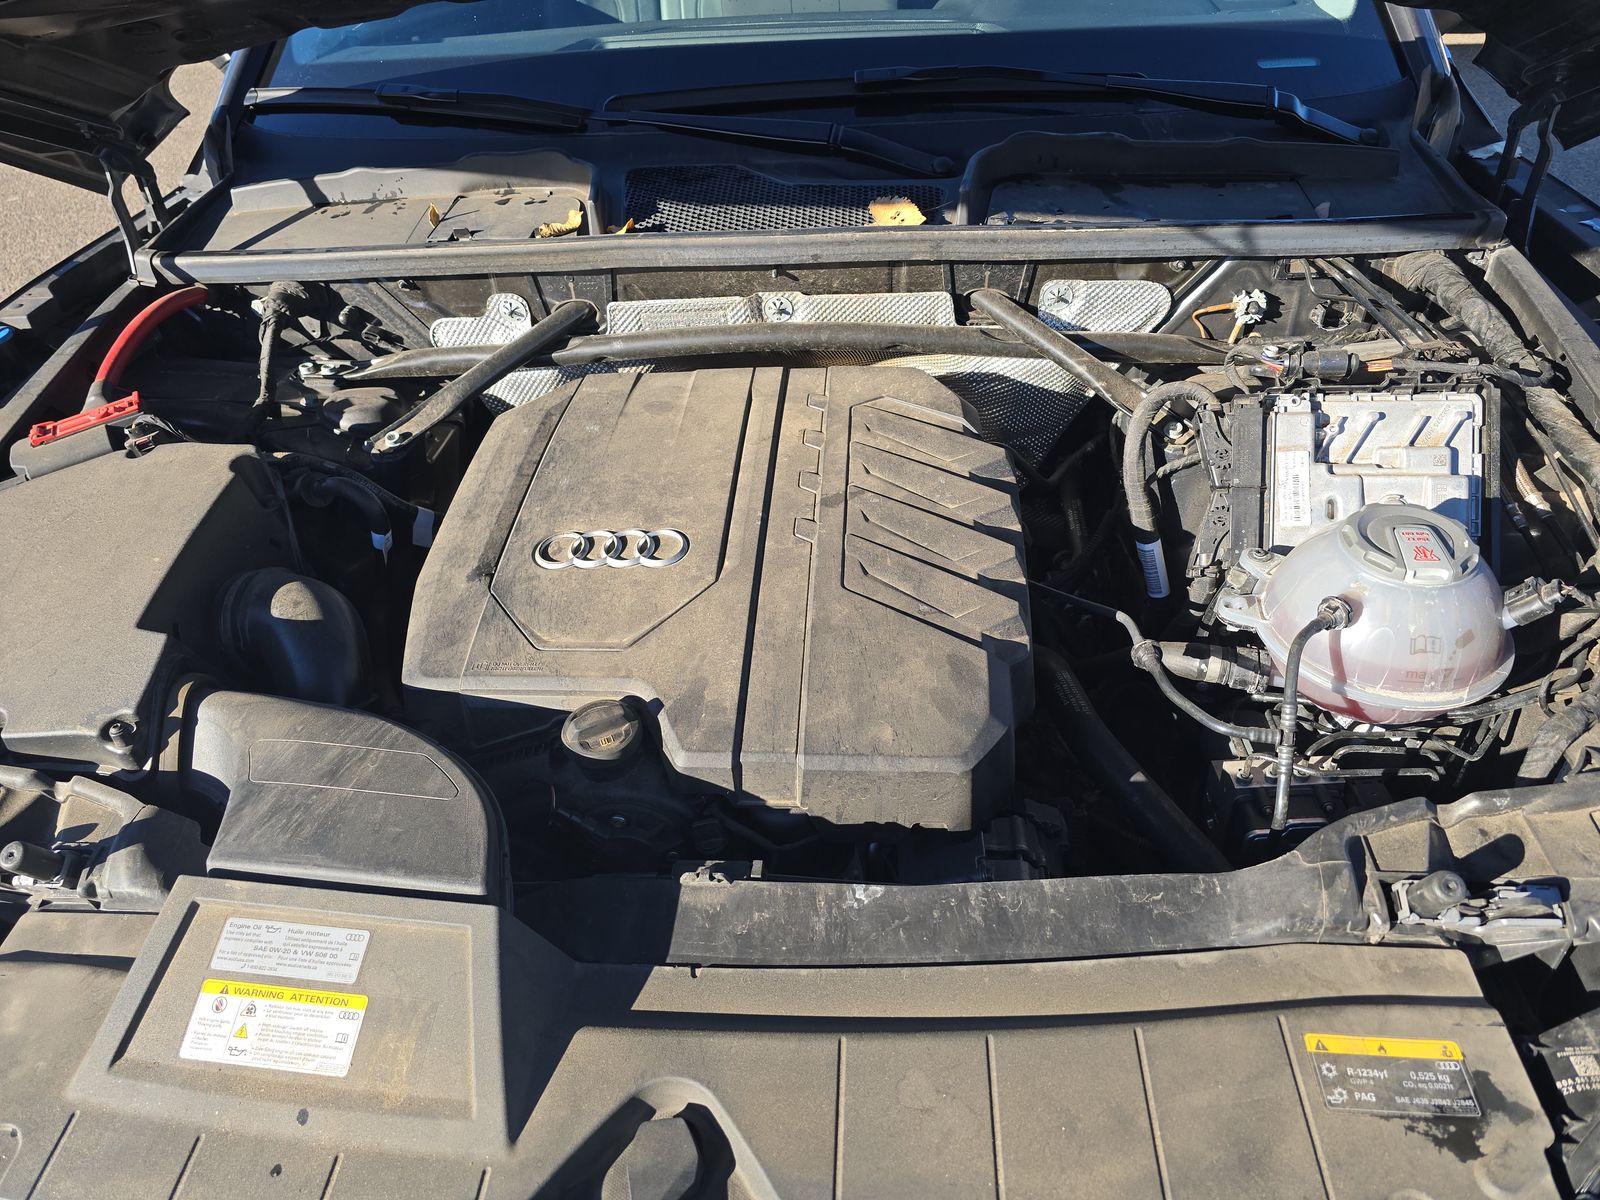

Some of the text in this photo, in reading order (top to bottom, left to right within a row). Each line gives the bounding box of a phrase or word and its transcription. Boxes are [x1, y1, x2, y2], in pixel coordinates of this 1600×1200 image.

[229, 922, 250, 930] Engine
[234, 987, 349, 1006] WARNING ATTENTION
[1347, 1067, 1450, 1083] R-1234yf 0,525 kg
[1354, 1092, 1376, 1102] PAG
